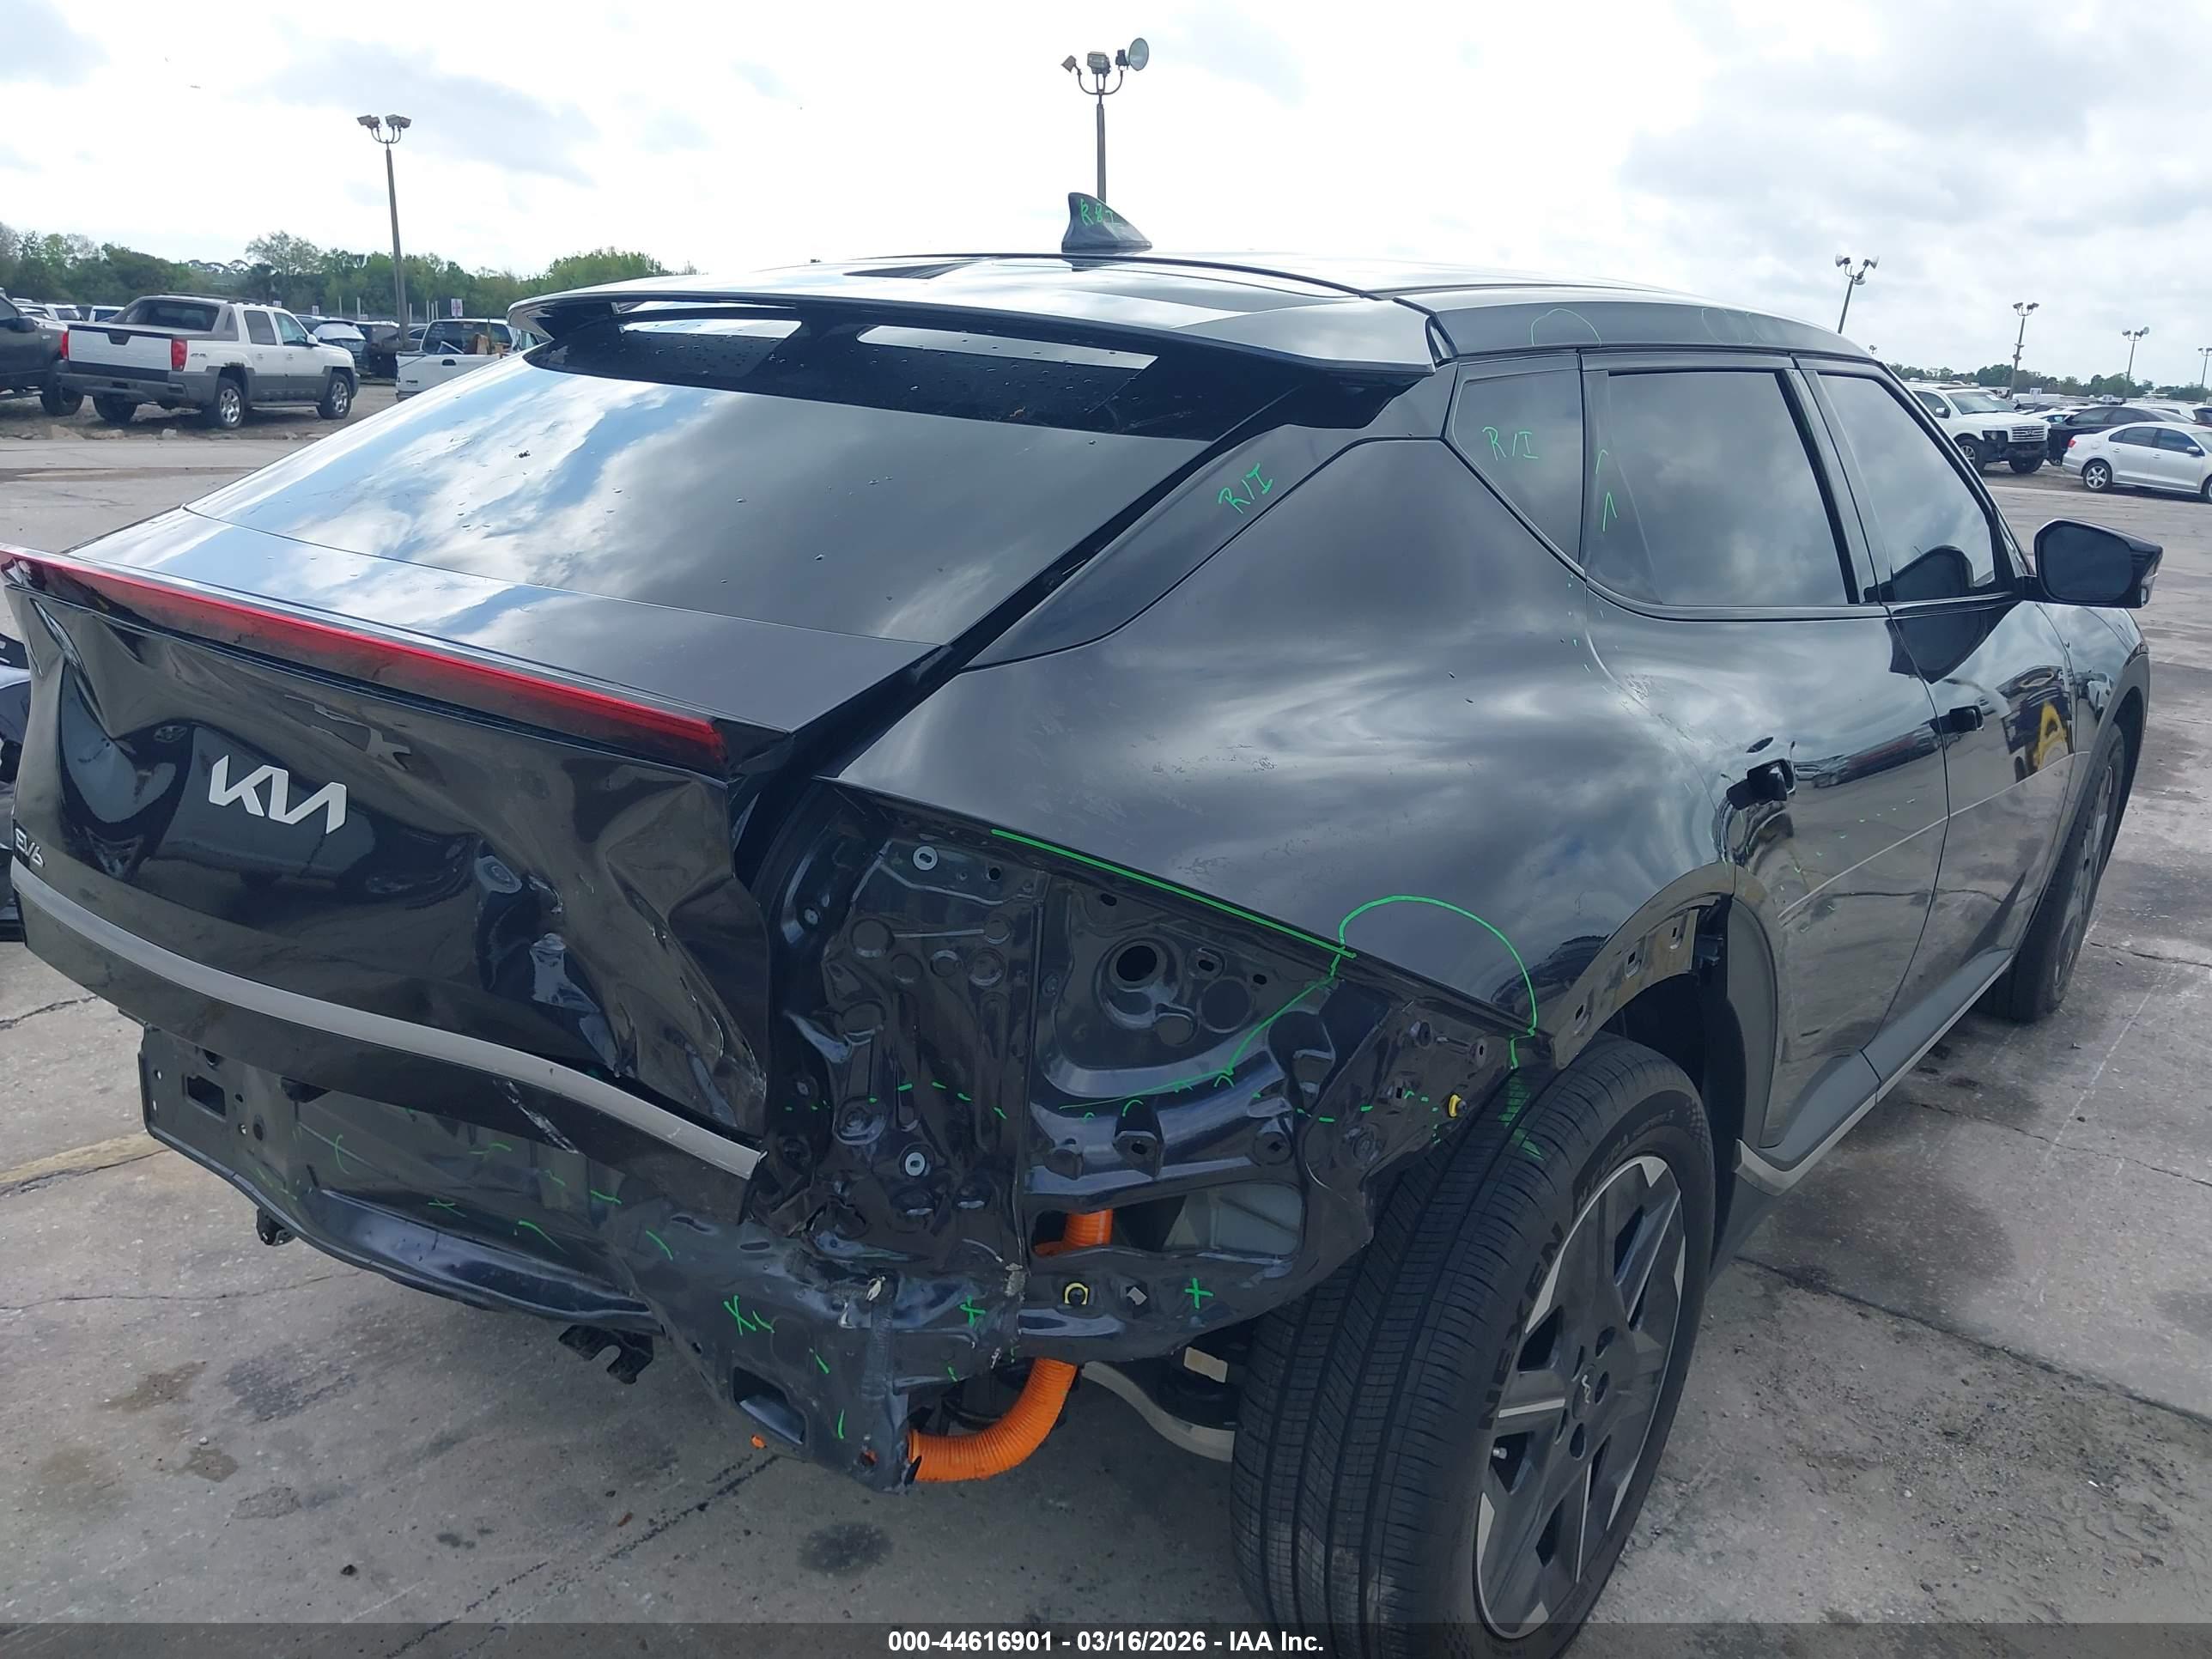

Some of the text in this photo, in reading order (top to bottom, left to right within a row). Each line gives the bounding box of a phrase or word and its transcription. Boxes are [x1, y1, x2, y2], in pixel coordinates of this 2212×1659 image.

[208, 755, 348, 835] KIA
[15, 828, 44, 868] EV6
[1477, 1220, 1565, 1431] NEXEN
